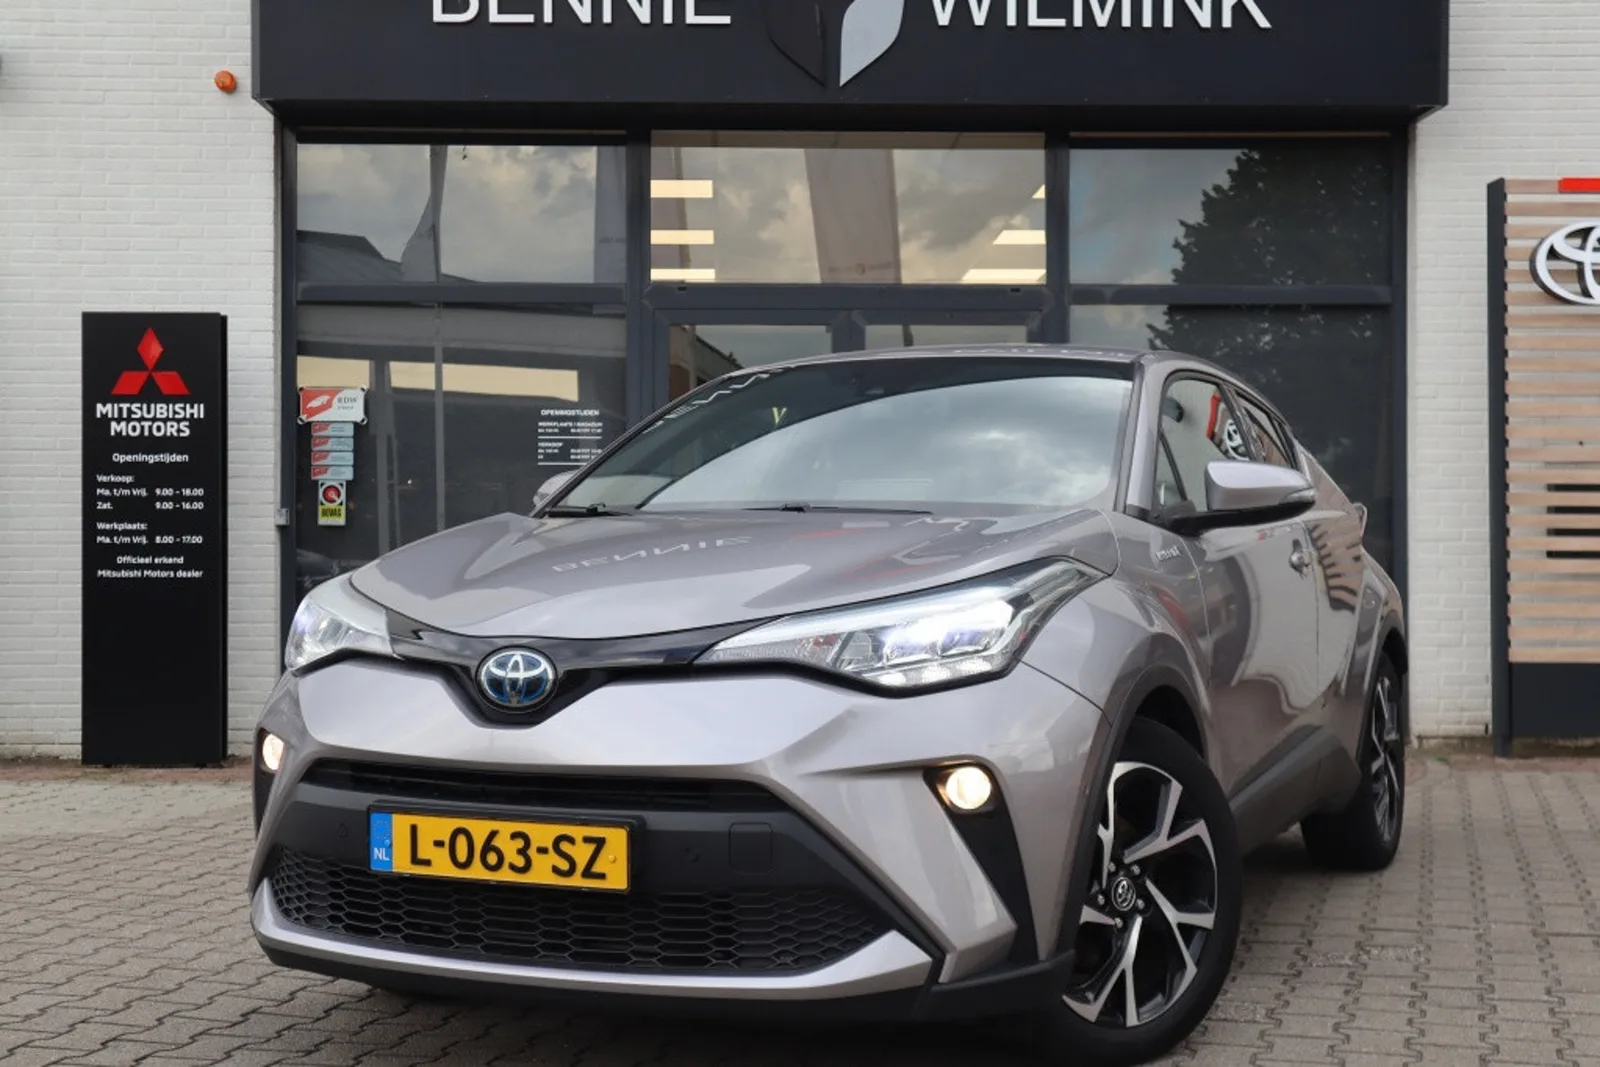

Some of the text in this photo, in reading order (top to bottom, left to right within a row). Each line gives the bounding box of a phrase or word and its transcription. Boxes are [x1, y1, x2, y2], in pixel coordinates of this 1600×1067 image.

[96, 403, 205, 419] MITSUBISHI
[110, 421, 191, 437] MOTORS
[112, 453, 189, 464] Openingstijden
[96, 474, 134, 484] Verkoop:
[96, 488, 112, 496] Ma.
[113, 488, 131, 496] t/m
[155, 488, 174, 496] 9.00
[181, 488, 204, 496] 18.00
[96, 501, 113, 510] Zat.
[155, 501, 174, 510] 9.00
[181, 501, 204, 510] 16.00
[96, 522, 148, 532] Werkplaats:
[96, 535, 112, 544] Ma.
[113, 535, 131, 544] t/m
[155, 535, 174, 544] 8.00
[181, 535, 203, 544] 17.00
[116, 555, 184, 564] Officieel erkend
[97, 569, 203, 578] Mitsubishi Motors dealer
[373, 824, 607, 880] NL L-063-SZ
